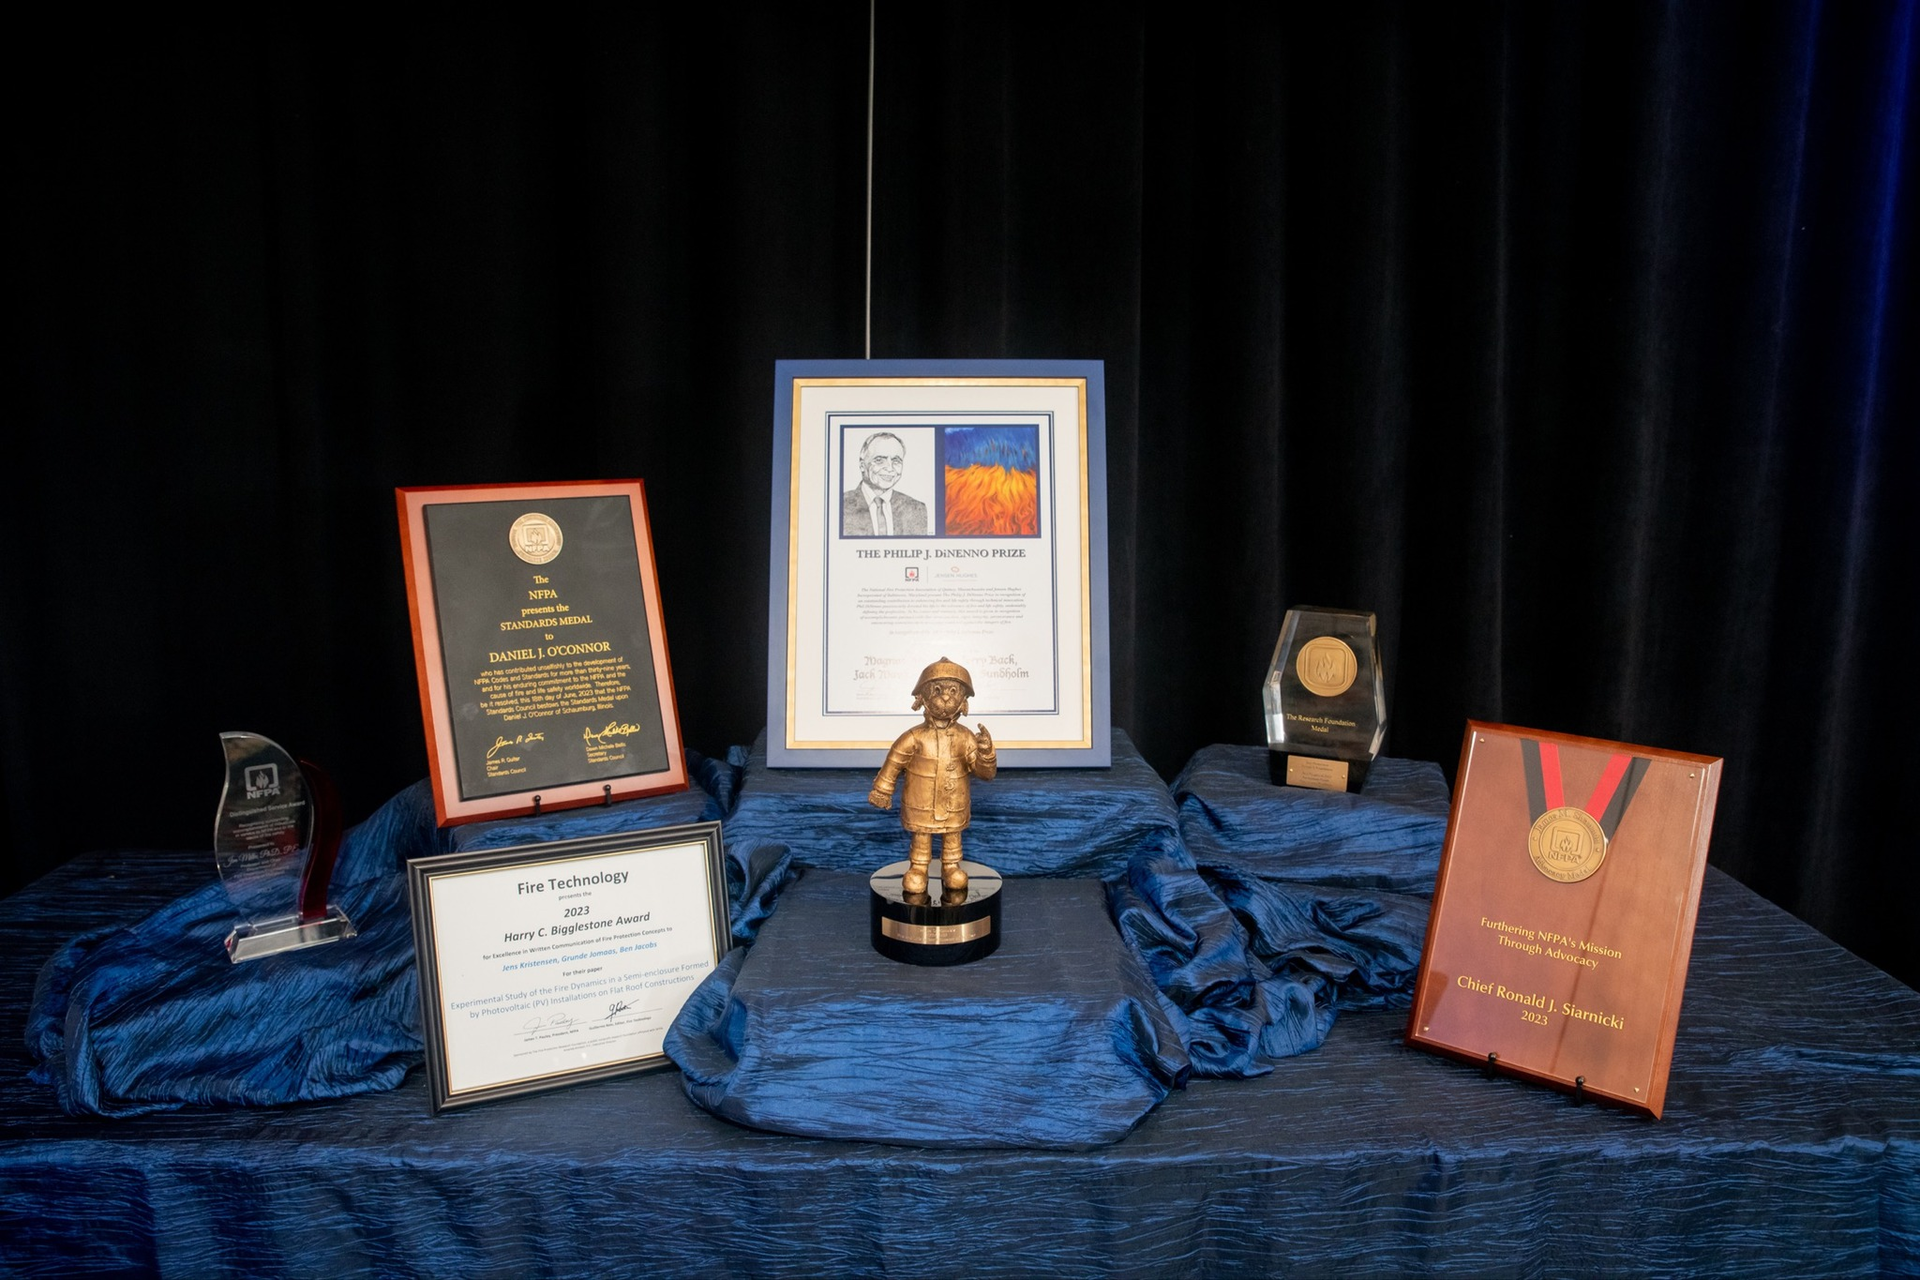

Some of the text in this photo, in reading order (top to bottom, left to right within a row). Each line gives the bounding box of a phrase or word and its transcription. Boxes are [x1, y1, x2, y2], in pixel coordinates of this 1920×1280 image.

[856, 549, 1026, 560] THE PHILIP J. DiNENNO PRIZE
[533, 575, 549, 584] The
[528, 589, 558, 600] NFPA
[521, 603, 570, 618] presents the
[500, 615, 593, 631] STANDARDS MEDAL
[489, 641, 612, 663] DANIEL J. O'CONNOR
[853, 668, 875, 681] Jack
[1298, 715, 1323, 723] Research
[1324, 718, 1356, 727] Foundation
[246, 788, 280, 800] NFPA
[1548, 852, 1580, 864] NFPA
[518, 871, 629, 895] Fire Technology
[558, 893, 582, 901] presents
[564, 905, 590, 918] 2023
[504, 912, 650, 943] Harry C. Bigglestone Award
[492, 950, 522, 959] Excellence
[552, 939, 595, 950] Communication
[613, 932, 641, 940] Protection
[1481, 917, 1622, 959] Furthering NFPA's Mission
[520, 958, 560, 969] Kristensen,
[561, 952, 588, 962] Grunde
[589, 949, 618, 958] Jomaas,
[634, 942, 657, 951] Jacobs
[1498, 934, 1599, 970] Through Advocacy
[450, 994, 504, 1010] Experimental
[505, 991, 528, 1001] Study
[529, 988, 537, 997] of
[539, 988, 553, 996] the
[570, 979, 607, 990] Dynamics
[624, 966, 680, 981] Semi-enclosure
[681, 960, 709, 971] Formed
[470, 1011, 480, 1019] by
[481, 1002, 531, 1016] Photovoltaic
[532, 998, 549, 1009] (PV)
[550, 992, 597, 1004] Installations
[625, 982, 643, 991] Roof
[644, 975, 695, 988] Constructions
[1457, 975, 1624, 1030] Chief Ronald J. Siarnicki
[1521, 1010, 1548, 1026] 2023
